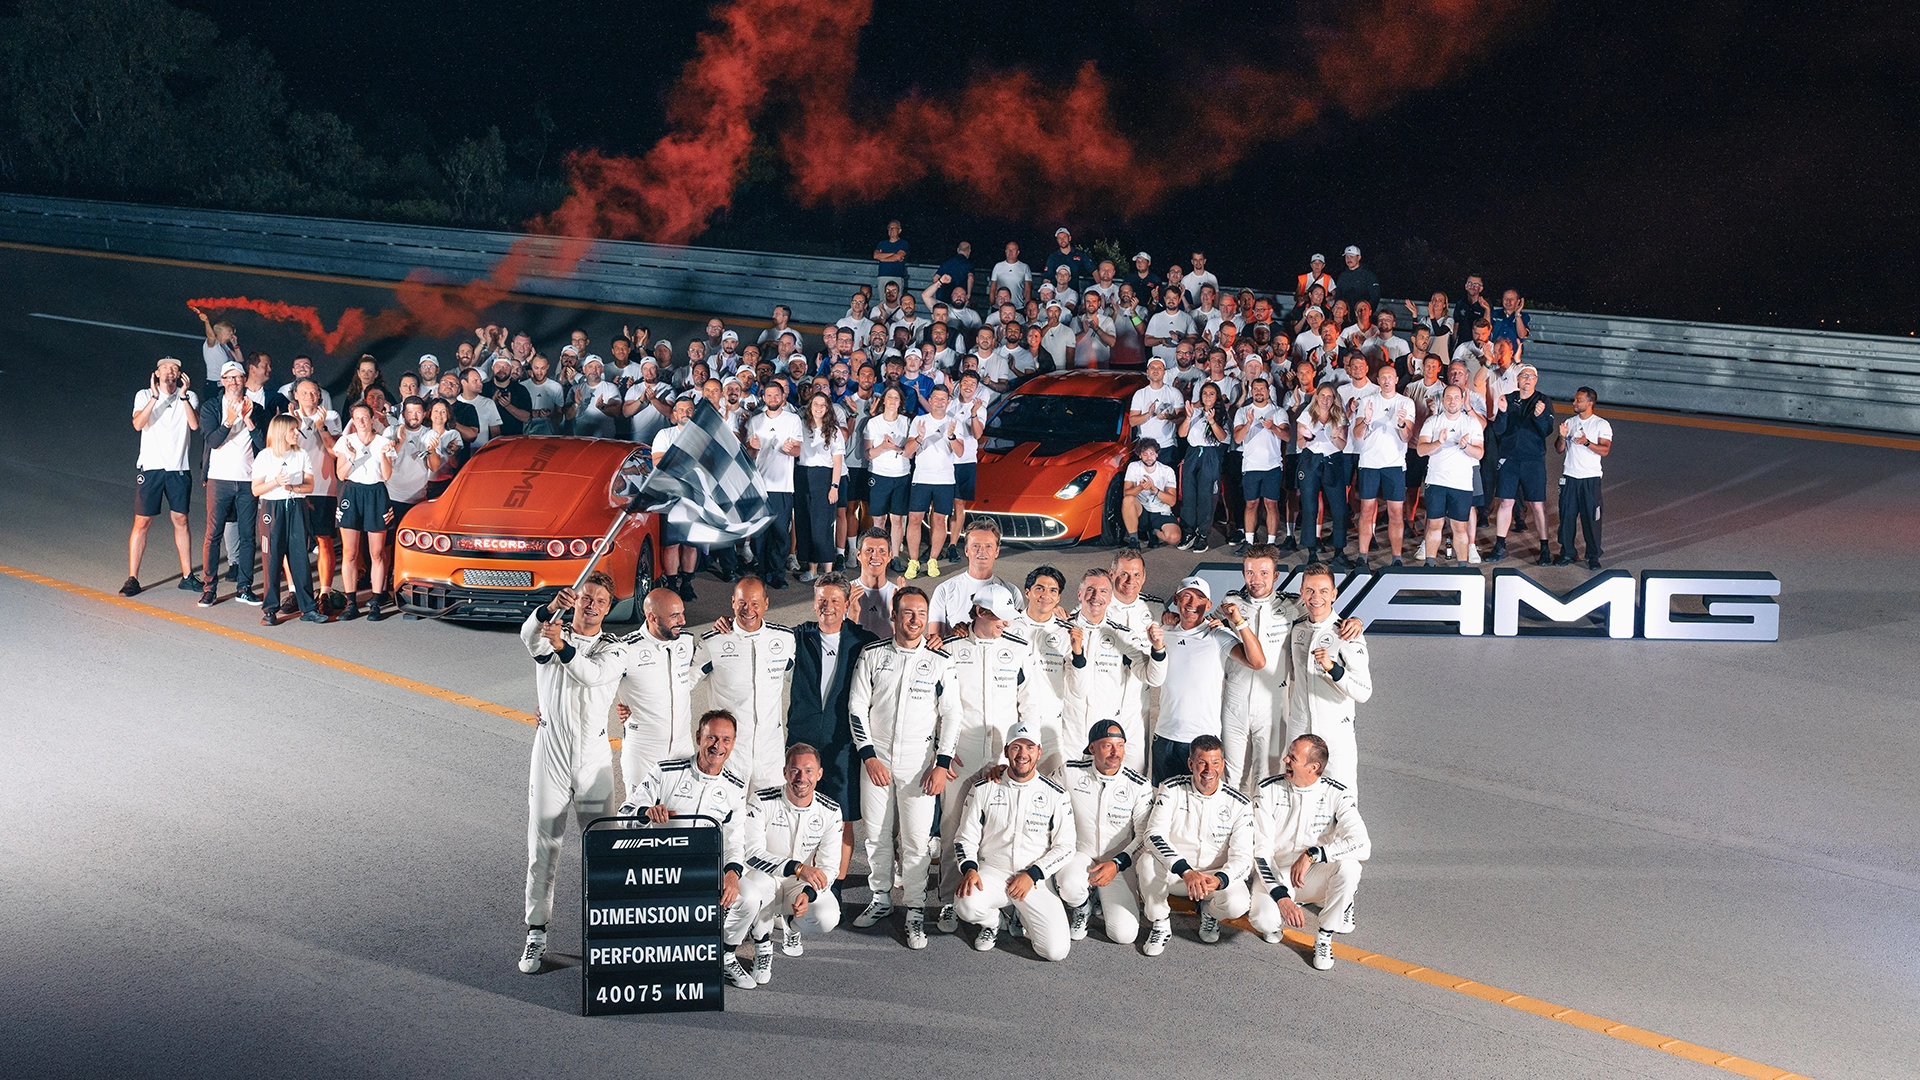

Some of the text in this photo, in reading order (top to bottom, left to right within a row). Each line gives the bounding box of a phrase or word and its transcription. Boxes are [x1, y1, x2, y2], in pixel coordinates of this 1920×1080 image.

[474, 538, 526, 549] RECORD
[1364, 568, 1782, 642] AMG
[636, 836, 689, 849] AMG
[624, 867, 682, 886] A NEW
[589, 905, 717, 926] DIMENSION OF
[590, 944, 717, 965] PERFORMANCE
[596, 983, 704, 1004] 40075 KM
